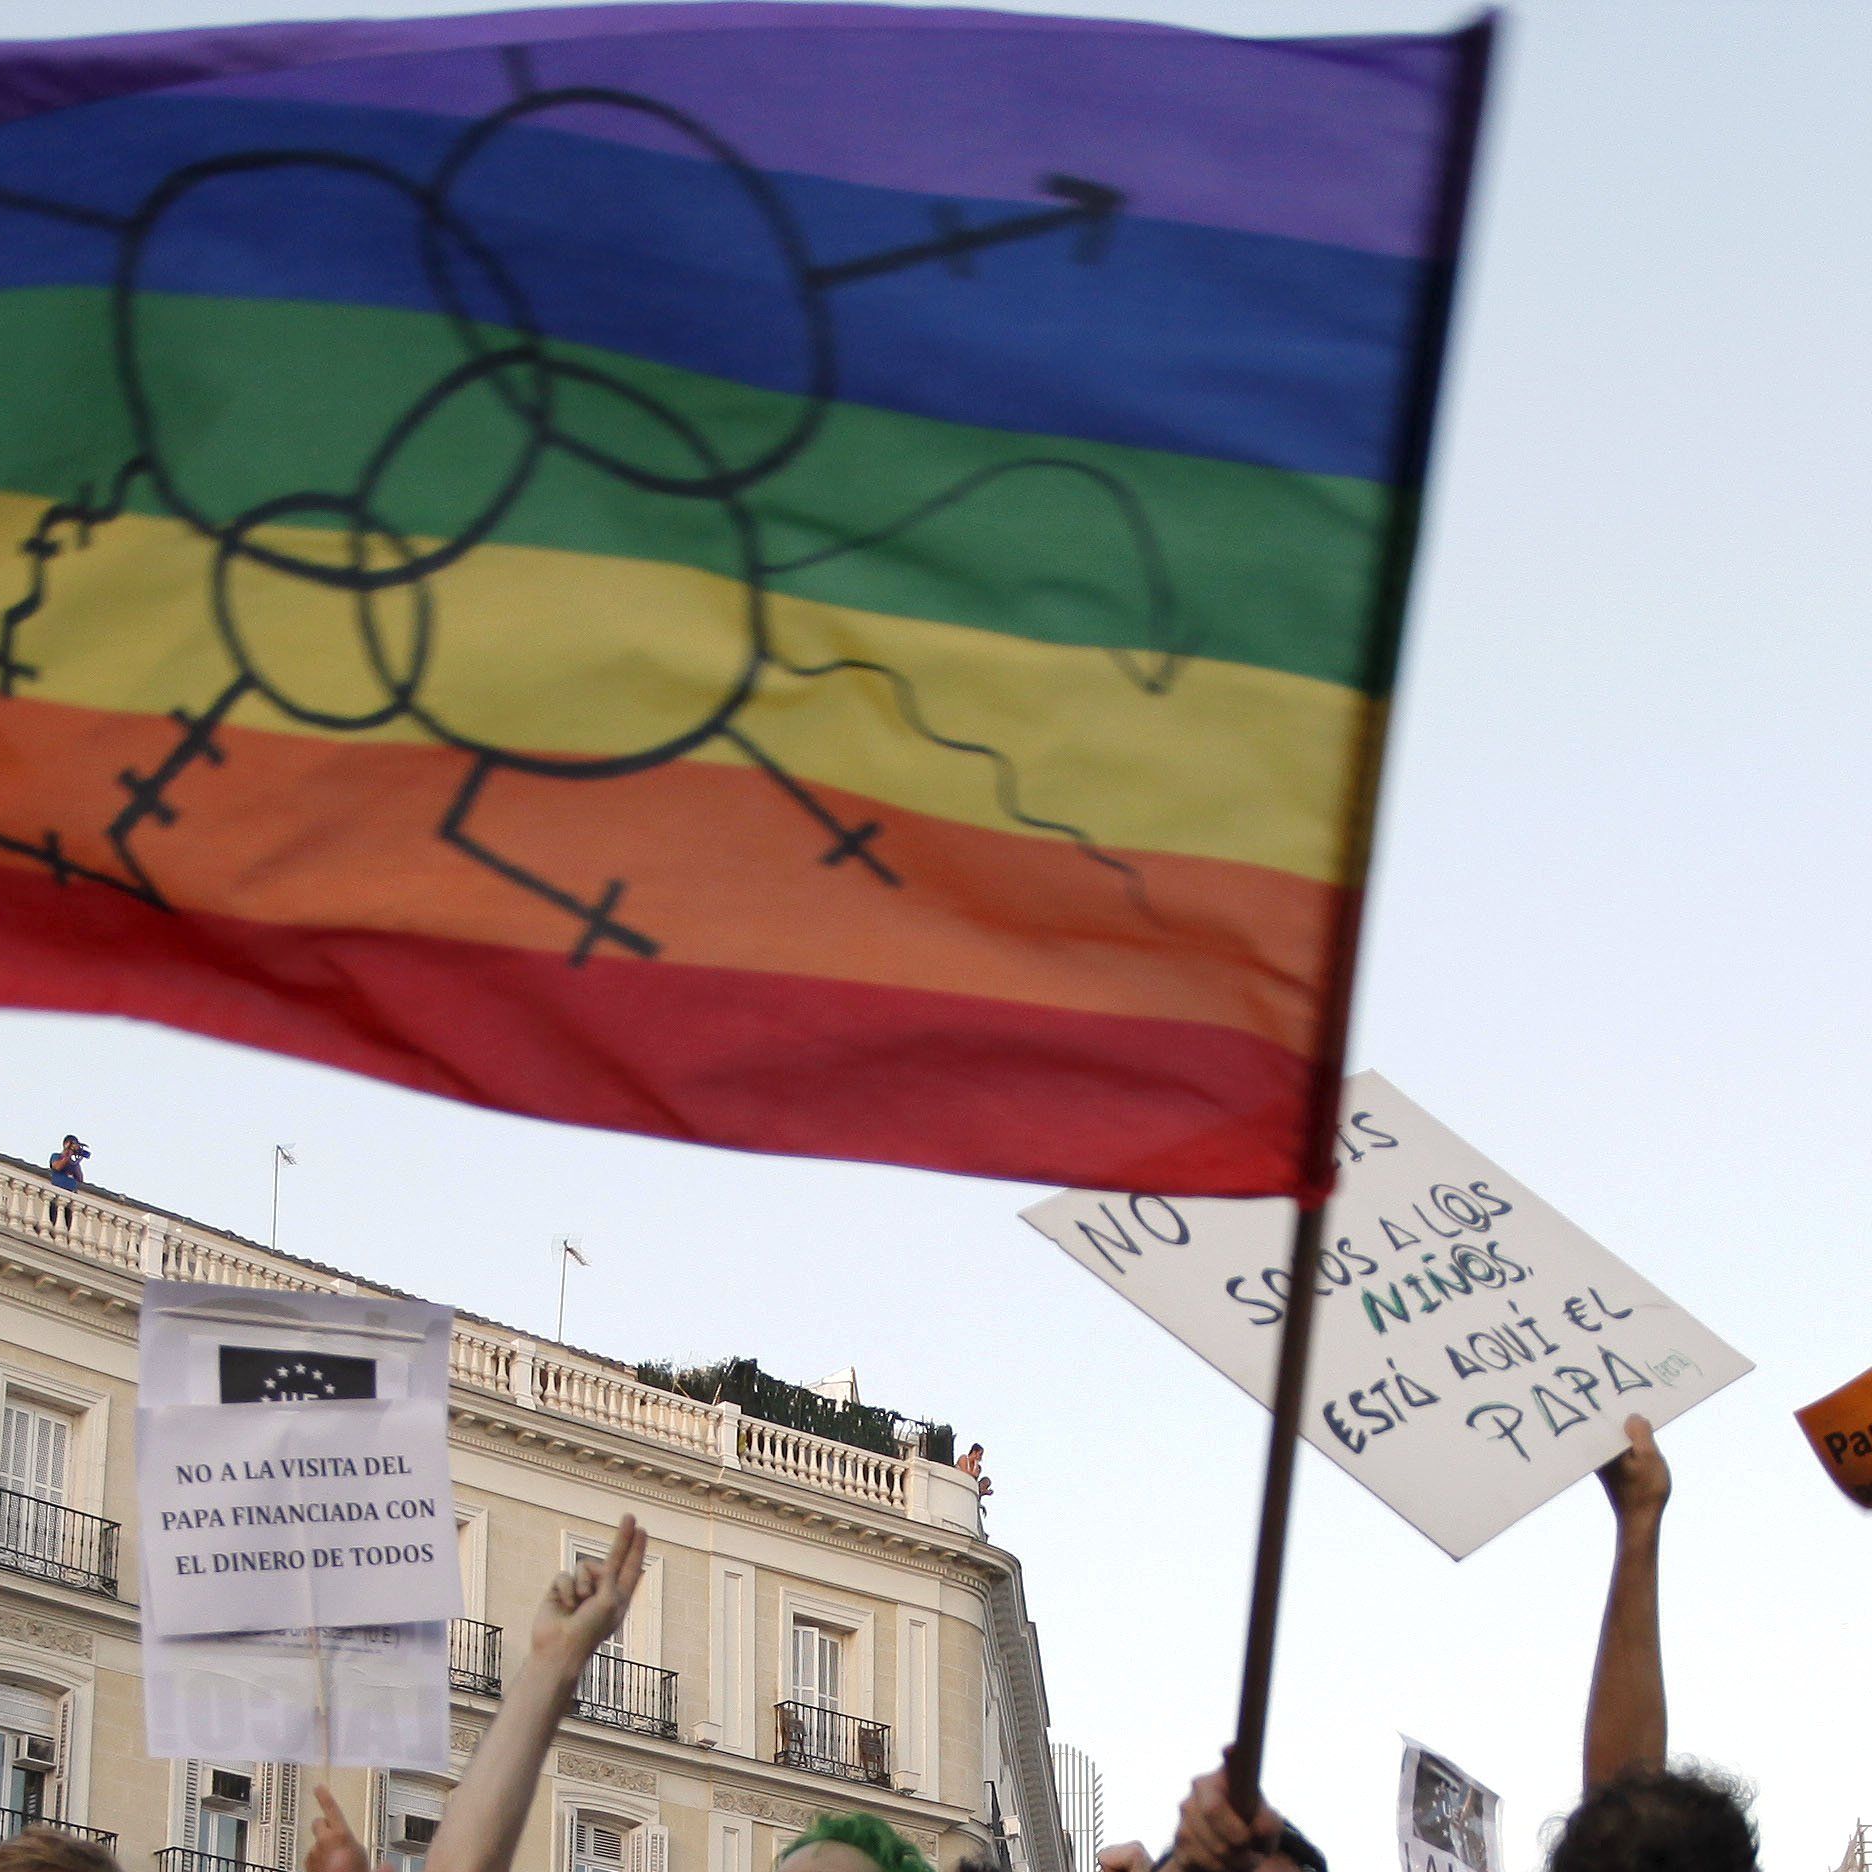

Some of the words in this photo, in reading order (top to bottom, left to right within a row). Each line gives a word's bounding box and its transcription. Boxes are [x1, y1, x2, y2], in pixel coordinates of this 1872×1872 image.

[1077, 1191, 1192, 1275] NO
[1225, 1236, 1379, 1325] SOOS
[1377, 1215, 1422, 1251] A
[1563, 1286, 1635, 1332] EL
[1465, 1344, 1653, 1463] PAPA
[176, 1464, 213, 1485] NO
[220, 1463, 238, 1481] A
[243, 1461, 276, 1481] LA
[279, 1457, 360, 1480] VISITA
[364, 1455, 413, 1477] DEL
[161, 1509, 226, 1531] PAPA
[231, 1502, 379, 1527] FINANCIADA
[385, 1497, 437, 1521] CON
[175, 1555, 207, 1576] EL
[211, 1548, 306, 1573] DINERO
[311, 1547, 345, 1569] DE
[348, 1542, 435, 1568] TODOS
